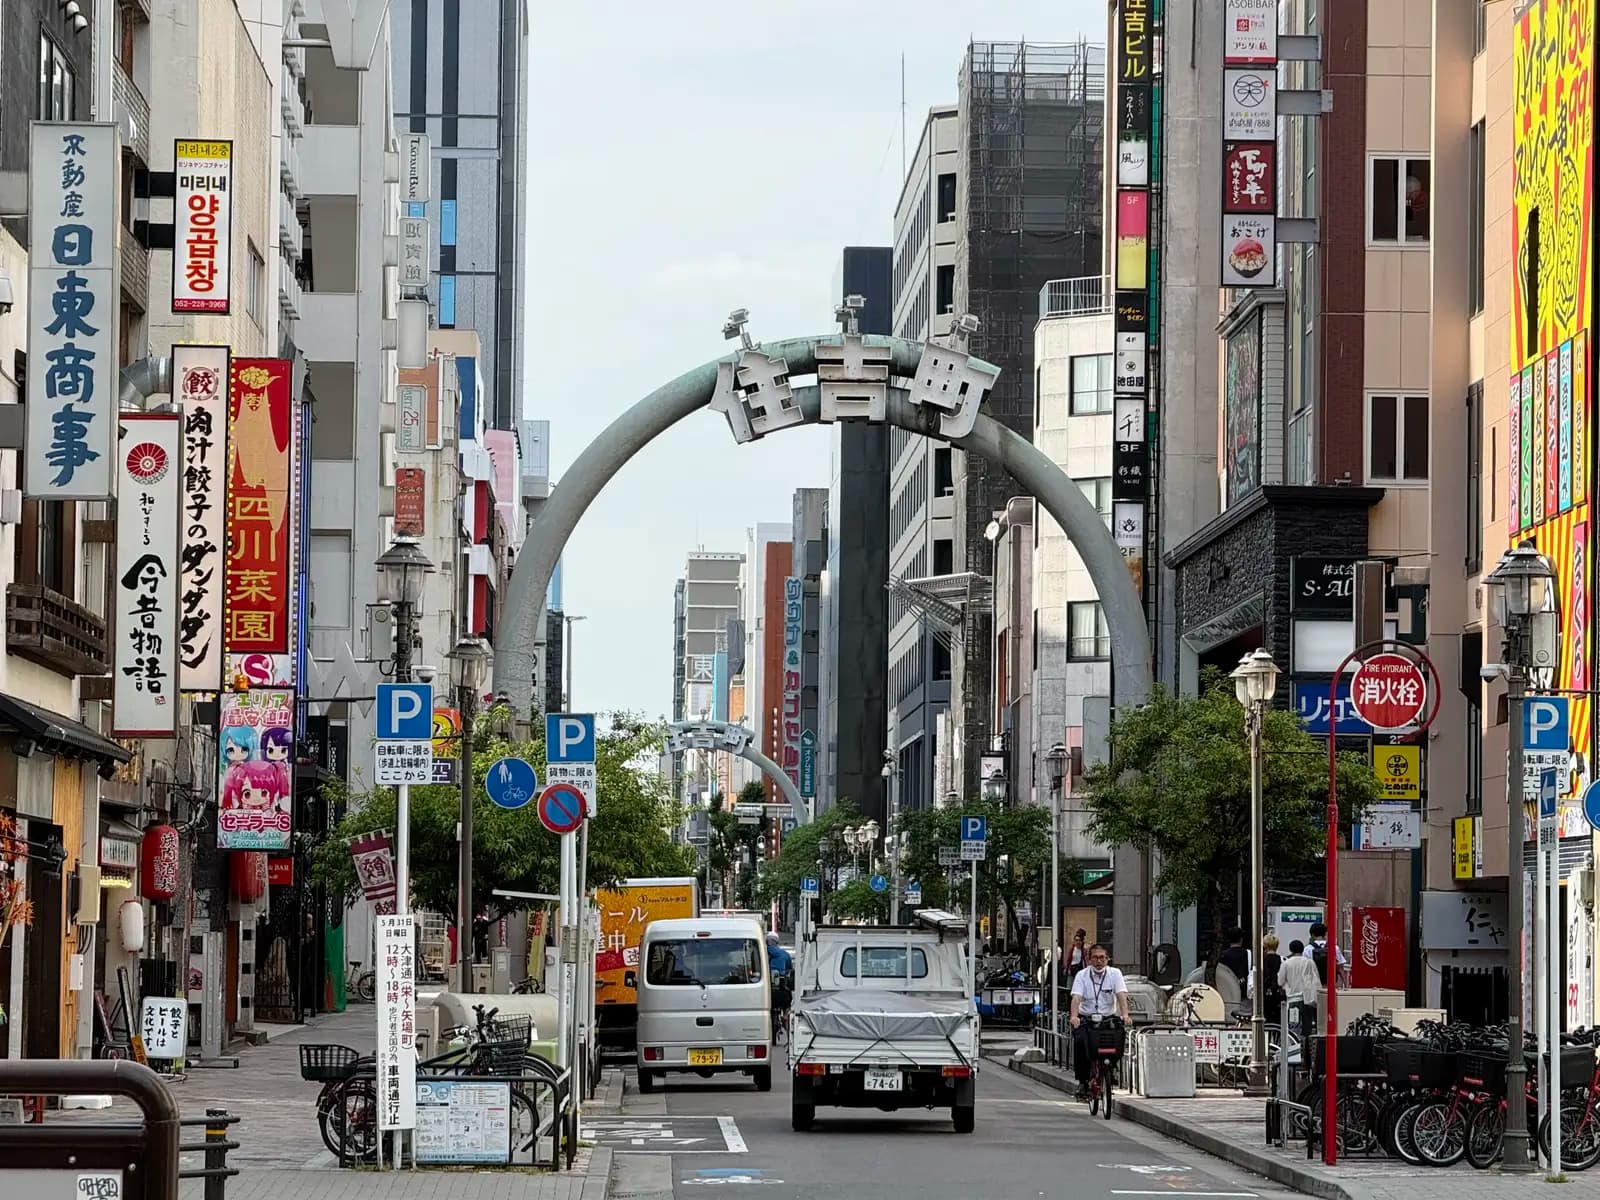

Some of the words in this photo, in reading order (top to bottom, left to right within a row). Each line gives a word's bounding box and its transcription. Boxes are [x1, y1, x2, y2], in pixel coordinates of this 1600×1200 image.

[60, 134, 86, 218] 不動産
[179, 175, 227, 192] 미리내
[1127, 195, 1139, 205] 5F
[1230, 226, 1270, 239] おこげ
[186, 193, 220, 293] 양곱창
[44, 223, 101, 487] 日東商事
[1117, 375, 1144, 388] 池田屋
[403, 410, 419, 427] 25
[1120, 444, 1140, 452] 3F
[181, 406, 216, 669] 肉汁餃子のダンダダン
[1120, 547, 1136, 557] 2F
[231, 496, 278, 642] 四川菜園
[121, 554, 167, 694] 今昔物語
[693, 654, 713, 680] 東
[1364, 664, 1380, 673] FIRE
[1381, 664, 1413, 673] HYDRANT
[236, 693, 288, 707] エリア
[1359, 677, 1420, 706] 消火栓
[391, 689, 422, 733] P
[1530, 702, 1559, 744] P
[559, 718, 586, 758] P
[377, 745, 430, 756] 自転車に限る
[378, 758, 429, 768] (歩道上駐輪場内)
[380, 770, 427, 781] ここから
[549, 767, 592, 777] 貨物に限る
[1380, 783, 1417, 791] とめぼれ
[968, 817, 982, 838] P
[381, 918, 412, 926] 5月31日
[598, 903, 649, 924] ール
[386, 928, 407, 937] 日曜日
[156, 1006, 168, 1047] ビールは
[170, 1007, 182, 1039] 餃子と
[872, 1078, 899, 1089] 74-61
[388, 1065, 400, 1126] 車両通行止
